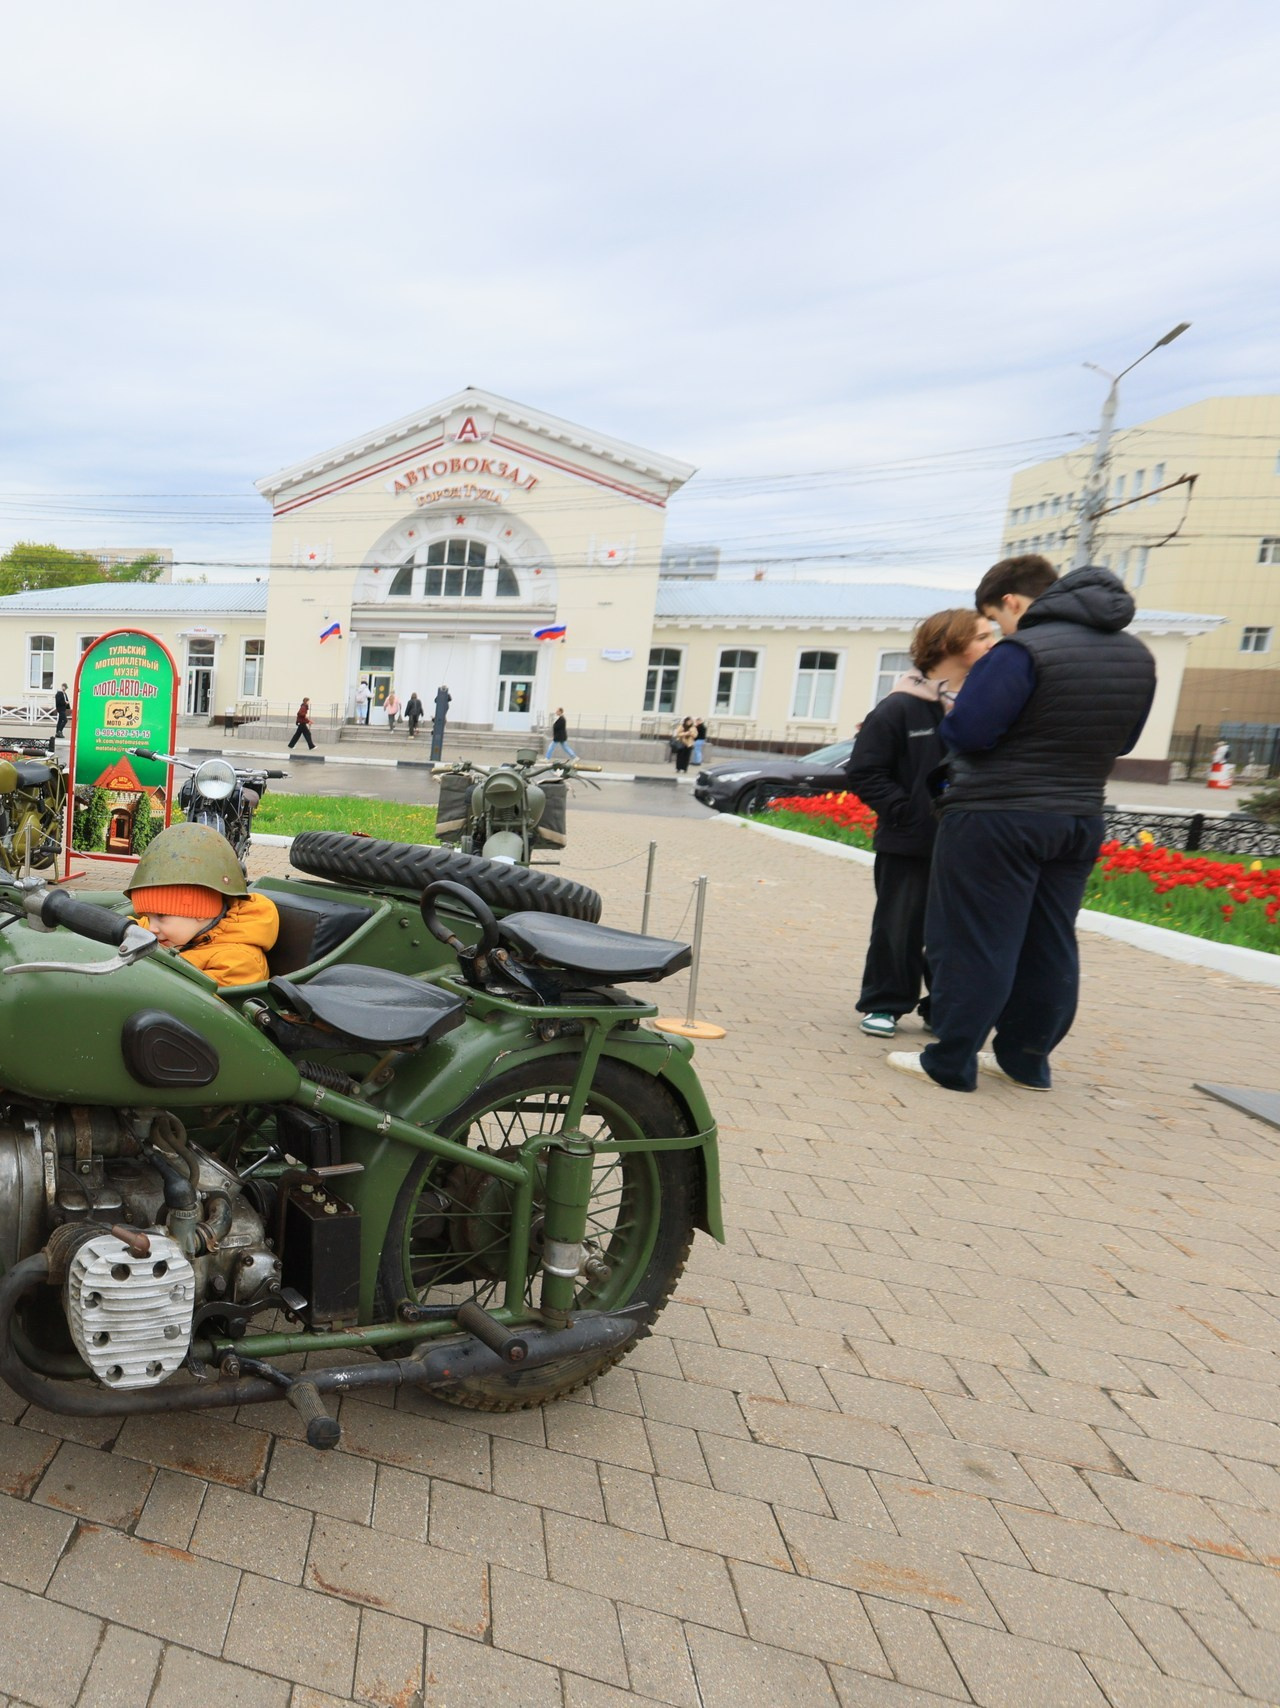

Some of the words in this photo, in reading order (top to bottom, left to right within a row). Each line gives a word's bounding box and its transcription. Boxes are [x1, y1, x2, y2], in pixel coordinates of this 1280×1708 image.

[457, 416, 480, 440] А
[393, 456, 540, 495] АВТОВОКЗАЛ
[109, 645, 146, 656] ТУЛЬСКИЙ
[95, 656, 159, 671] МОТОЦИКЛЕТНЫЙ
[114, 666, 139, 677] МУЗЕЙ
[93, 678, 158, 698] МОТО-АВТО-АРТ
